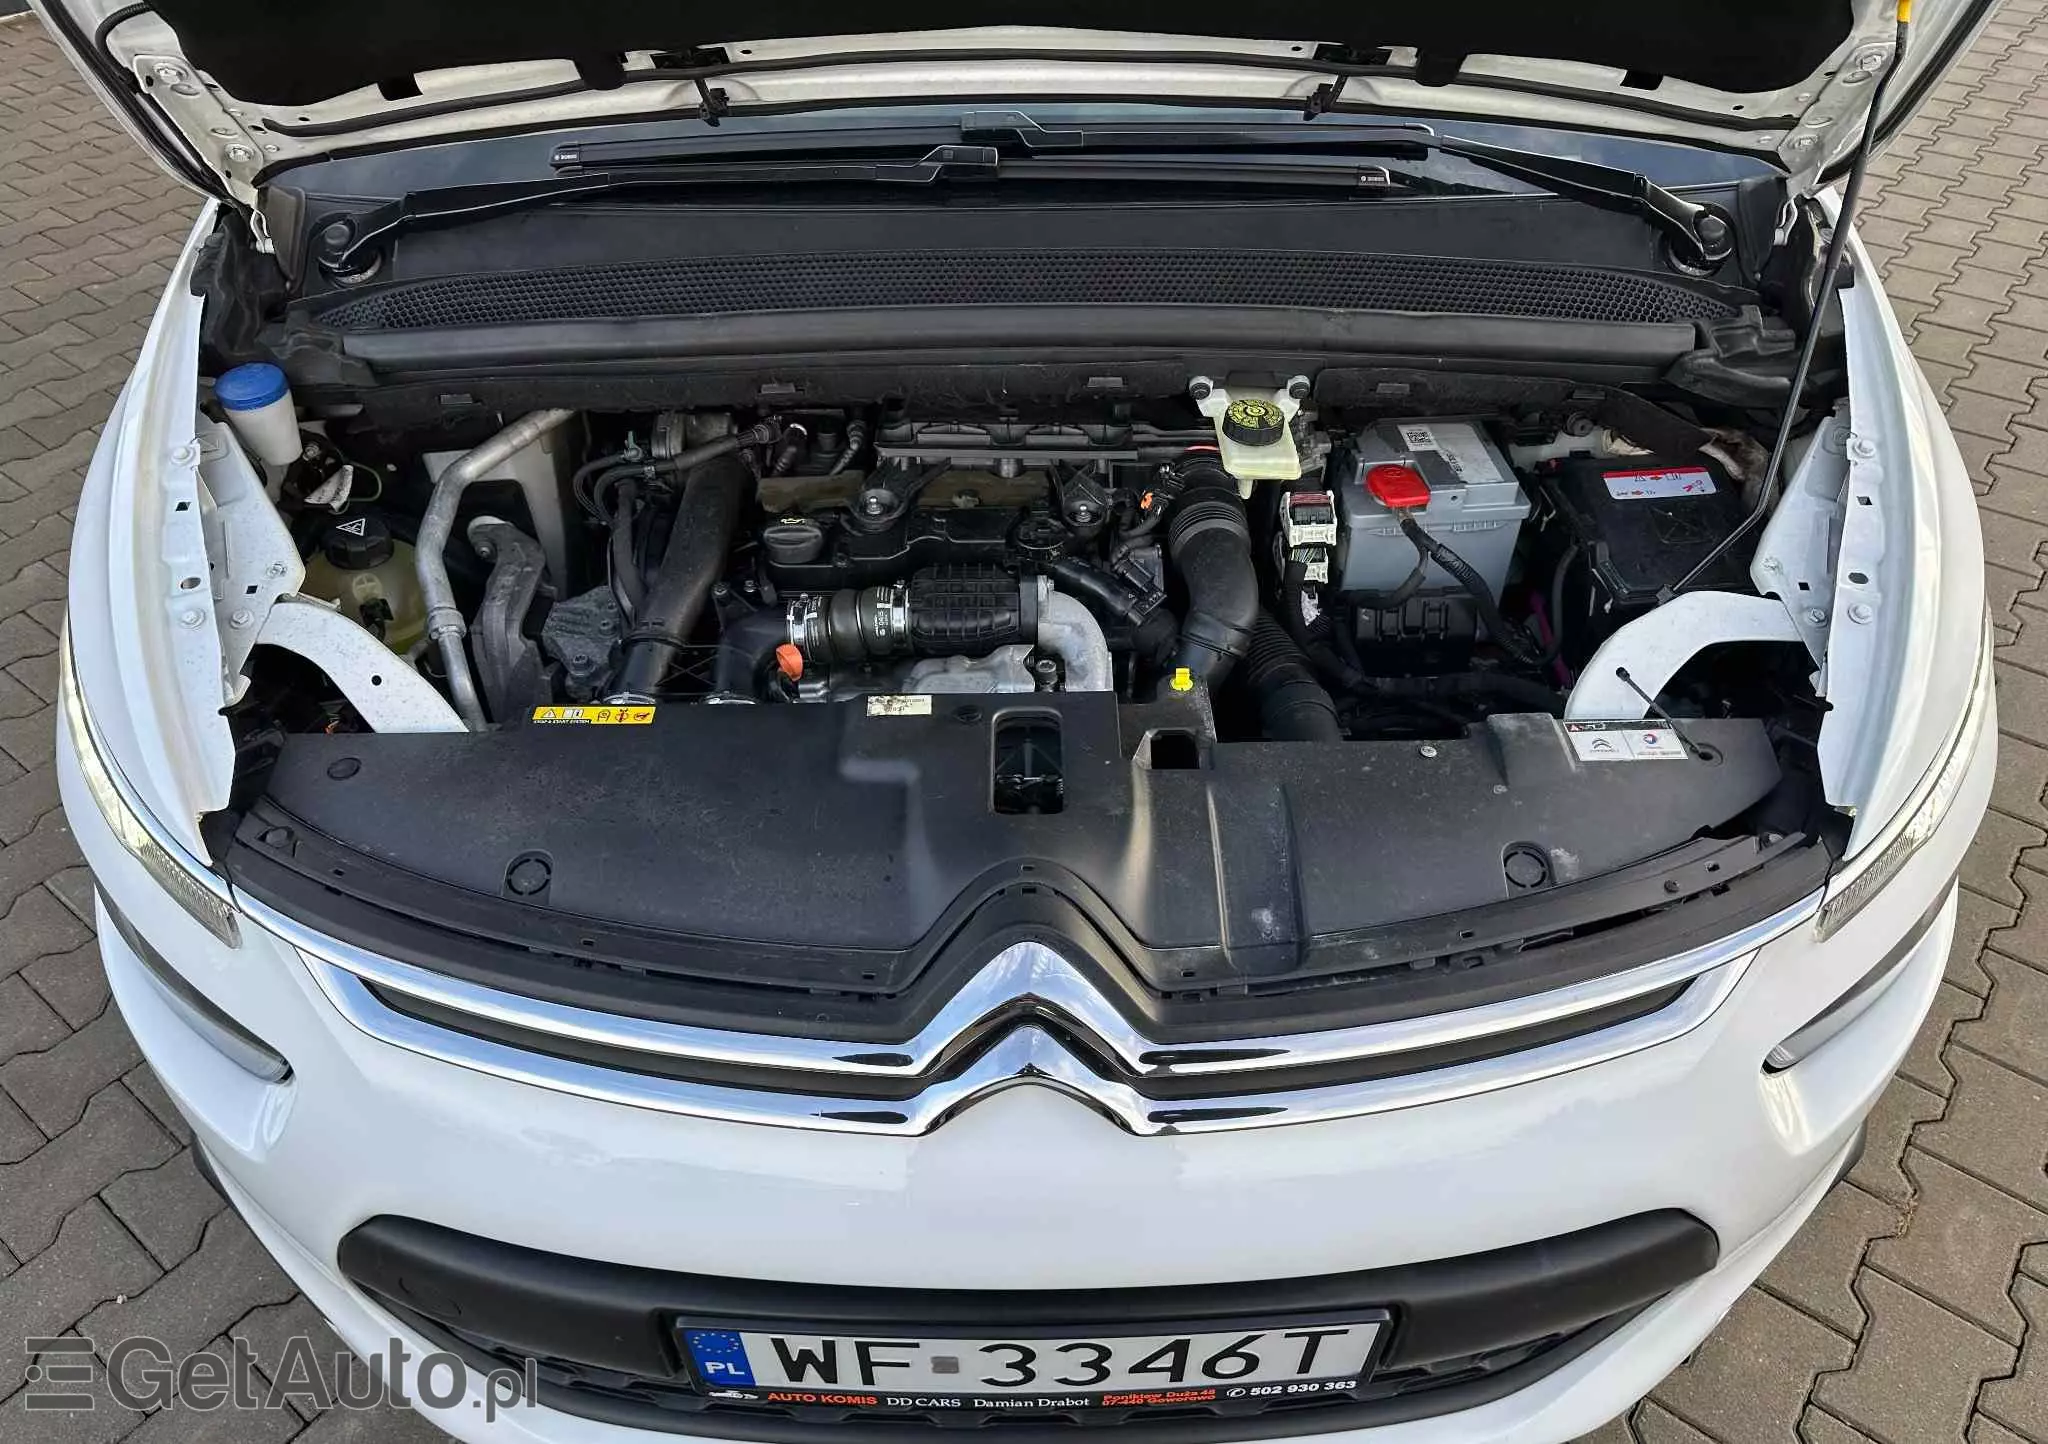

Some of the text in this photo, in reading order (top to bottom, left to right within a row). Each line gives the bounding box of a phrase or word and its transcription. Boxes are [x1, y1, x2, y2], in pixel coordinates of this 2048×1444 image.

[770, 1328, 1351, 1387] WF 3346T
[704, 1361, 745, 1376] PL
[1249, 1380, 1357, 1396] 502 930 363
[767, 1392, 878, 1405] AUTO KOMIS
[886, 1397, 961, 1408] DD CARS
[974, 1397, 1090, 1408] Damian Drabot
